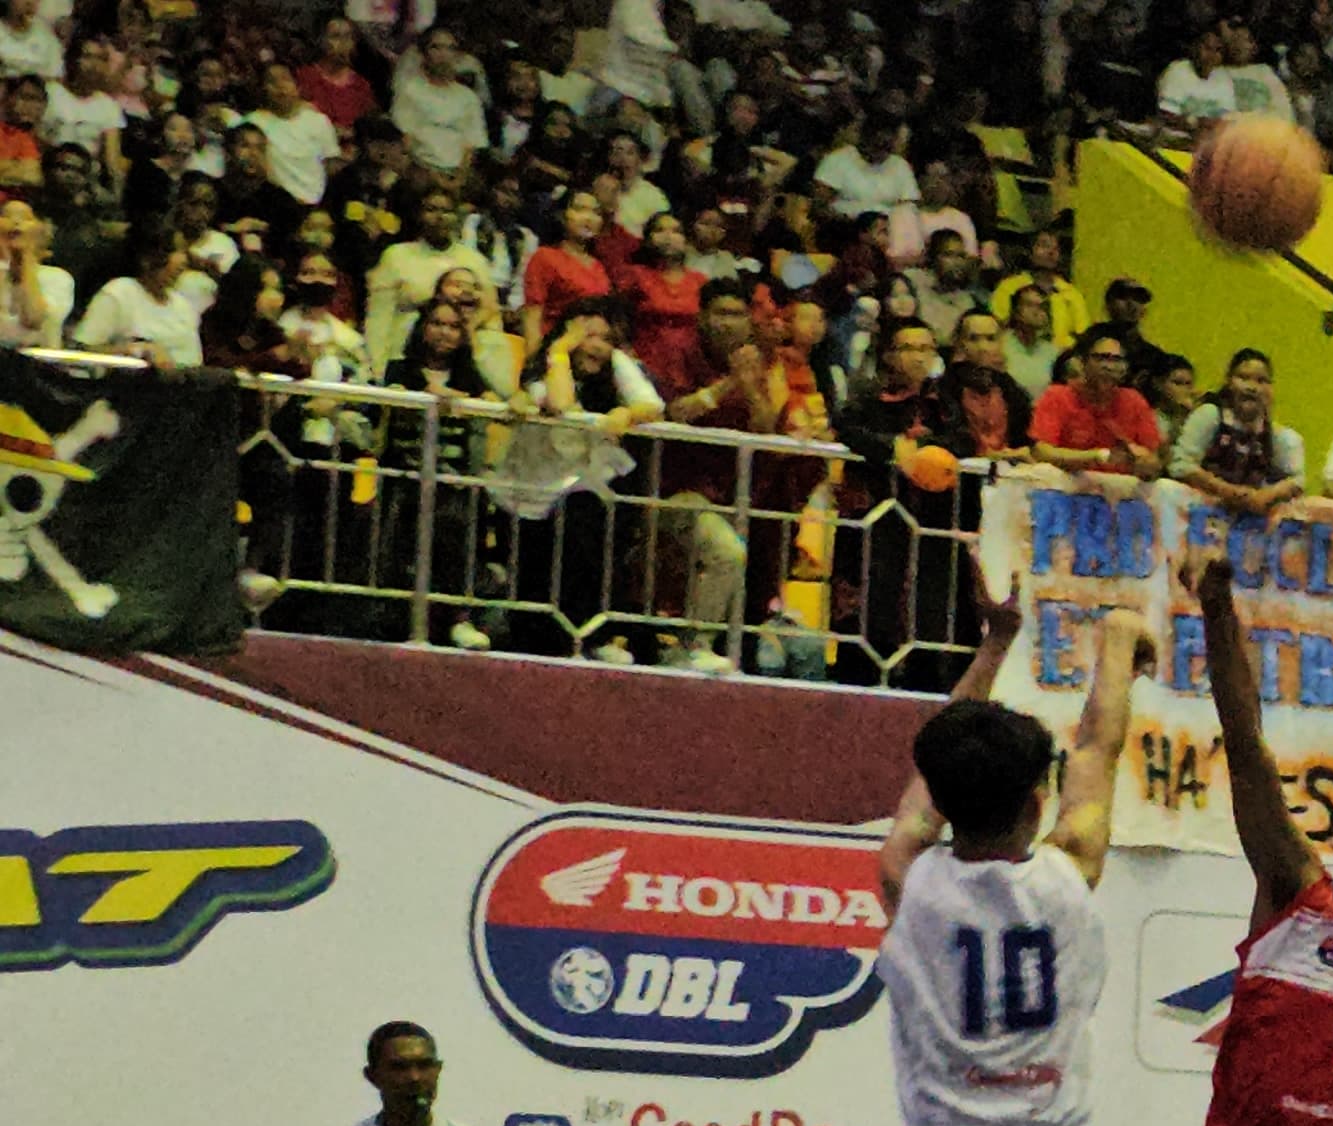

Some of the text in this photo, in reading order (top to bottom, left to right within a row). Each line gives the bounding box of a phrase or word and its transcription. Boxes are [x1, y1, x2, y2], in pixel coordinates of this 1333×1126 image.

[624, 873, 886, 927] HONDA
[613, 952, 750, 1021] DBL
[955, 925, 1057, 1037] 10
